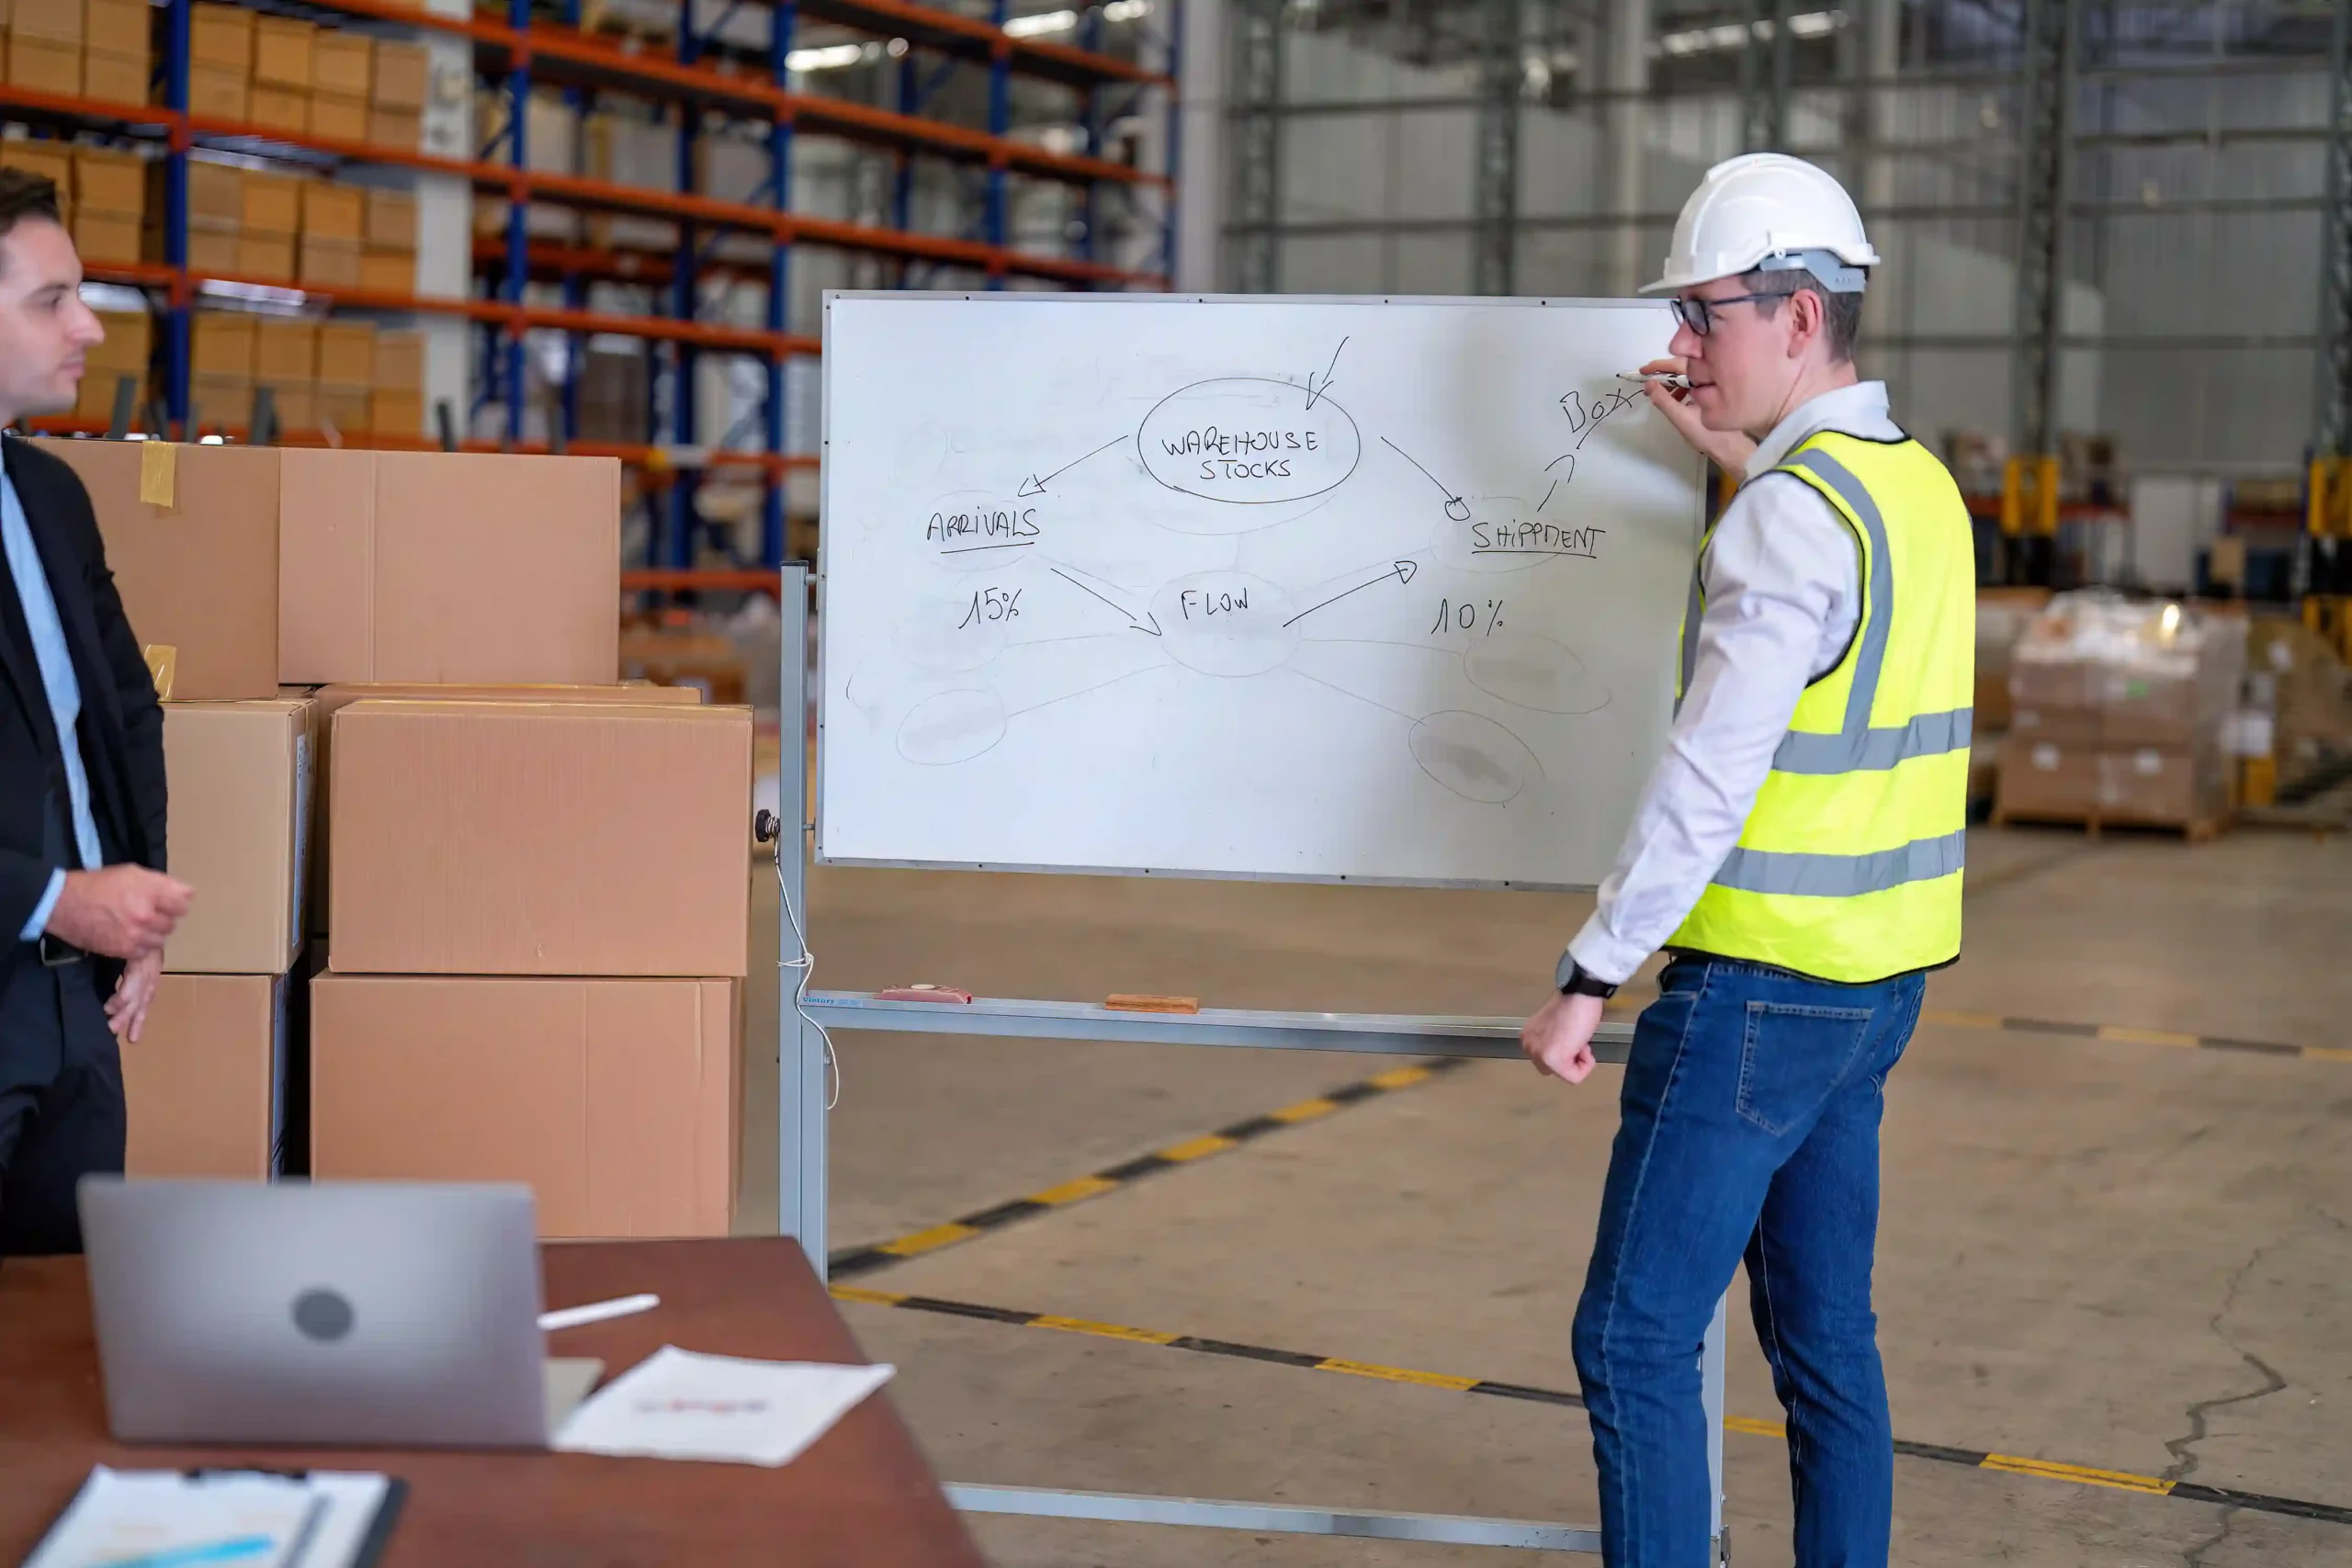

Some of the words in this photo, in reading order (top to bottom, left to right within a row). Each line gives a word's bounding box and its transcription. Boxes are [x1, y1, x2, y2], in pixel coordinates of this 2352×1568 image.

[1161, 425, 1318, 457] WAREHOUSE
[1199, 458, 1291, 480] STOCKS
[957, 586, 1023, 630] 15%
[1181, 587, 1249, 621] FLOW
[1430, 598, 1503, 637] 10%
